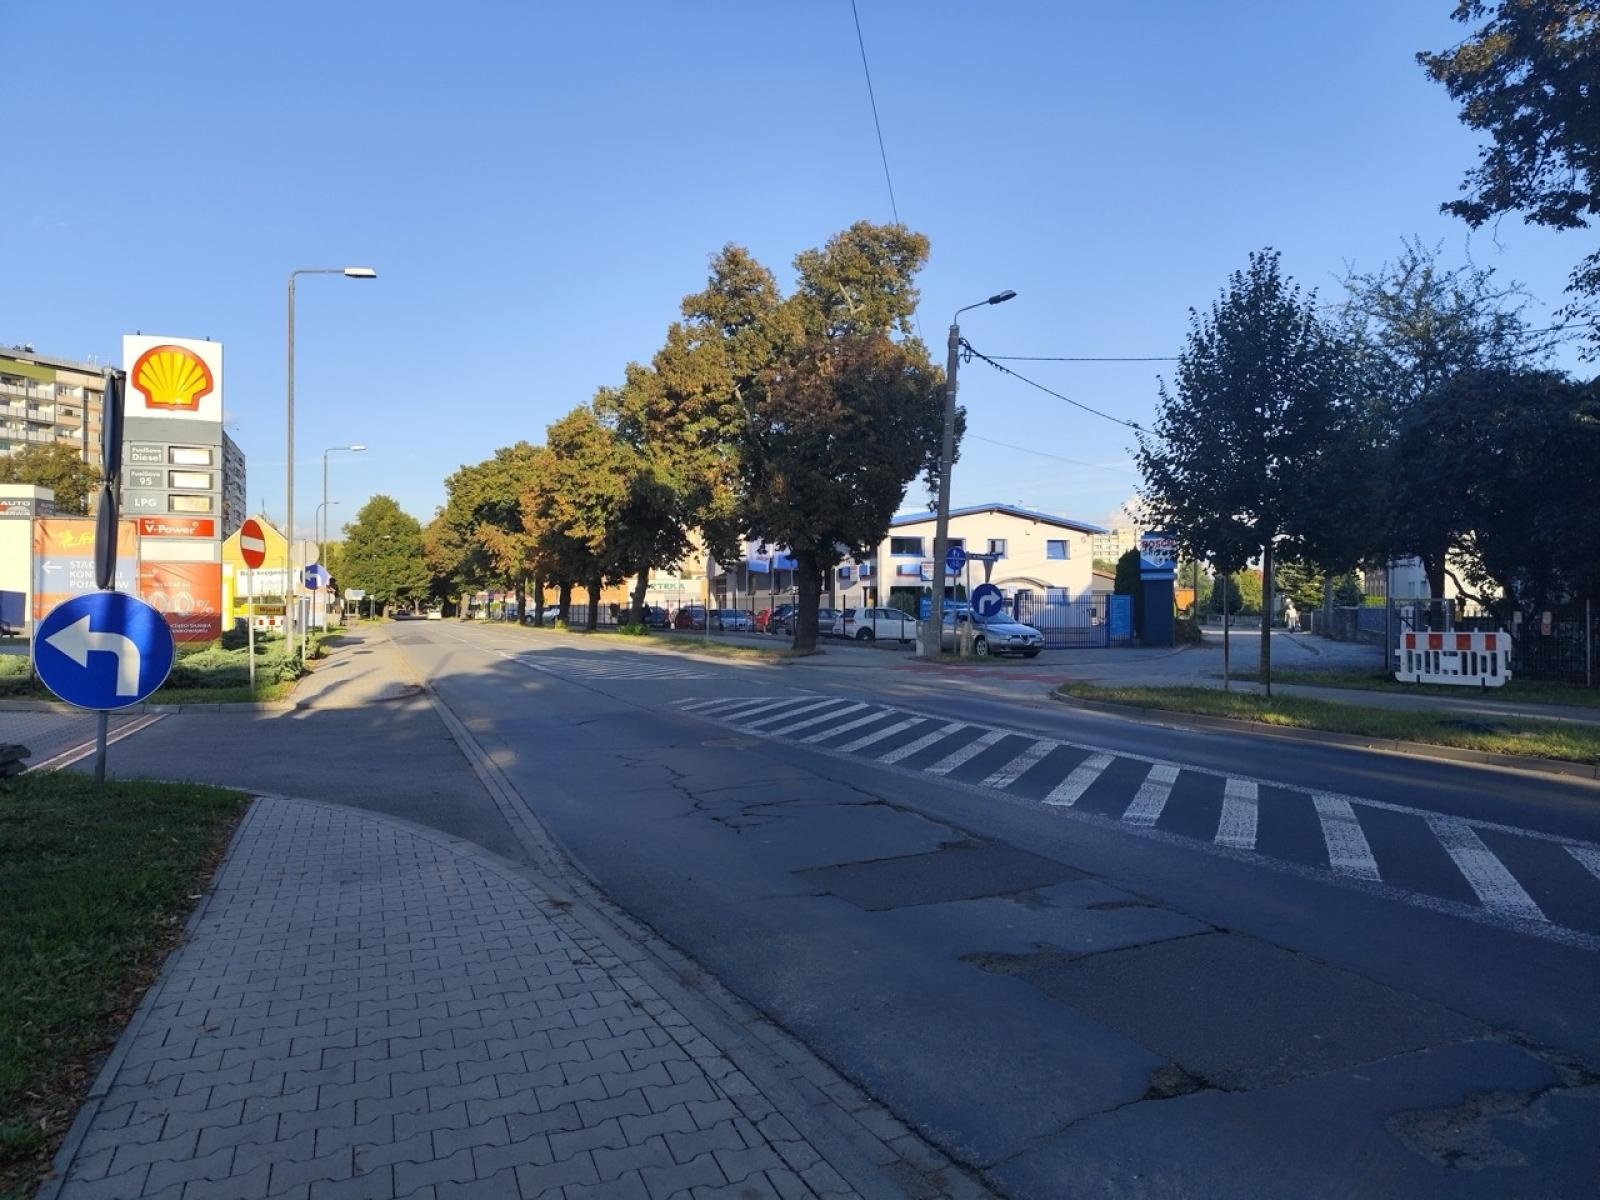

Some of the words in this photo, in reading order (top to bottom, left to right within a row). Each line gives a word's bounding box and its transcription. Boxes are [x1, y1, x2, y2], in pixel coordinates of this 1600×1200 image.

[131, 453, 162, 461] Diesel
[139, 477, 153, 486] 95
[134, 498, 158, 507] LPG
[145, 524, 195, 535] V-Power
